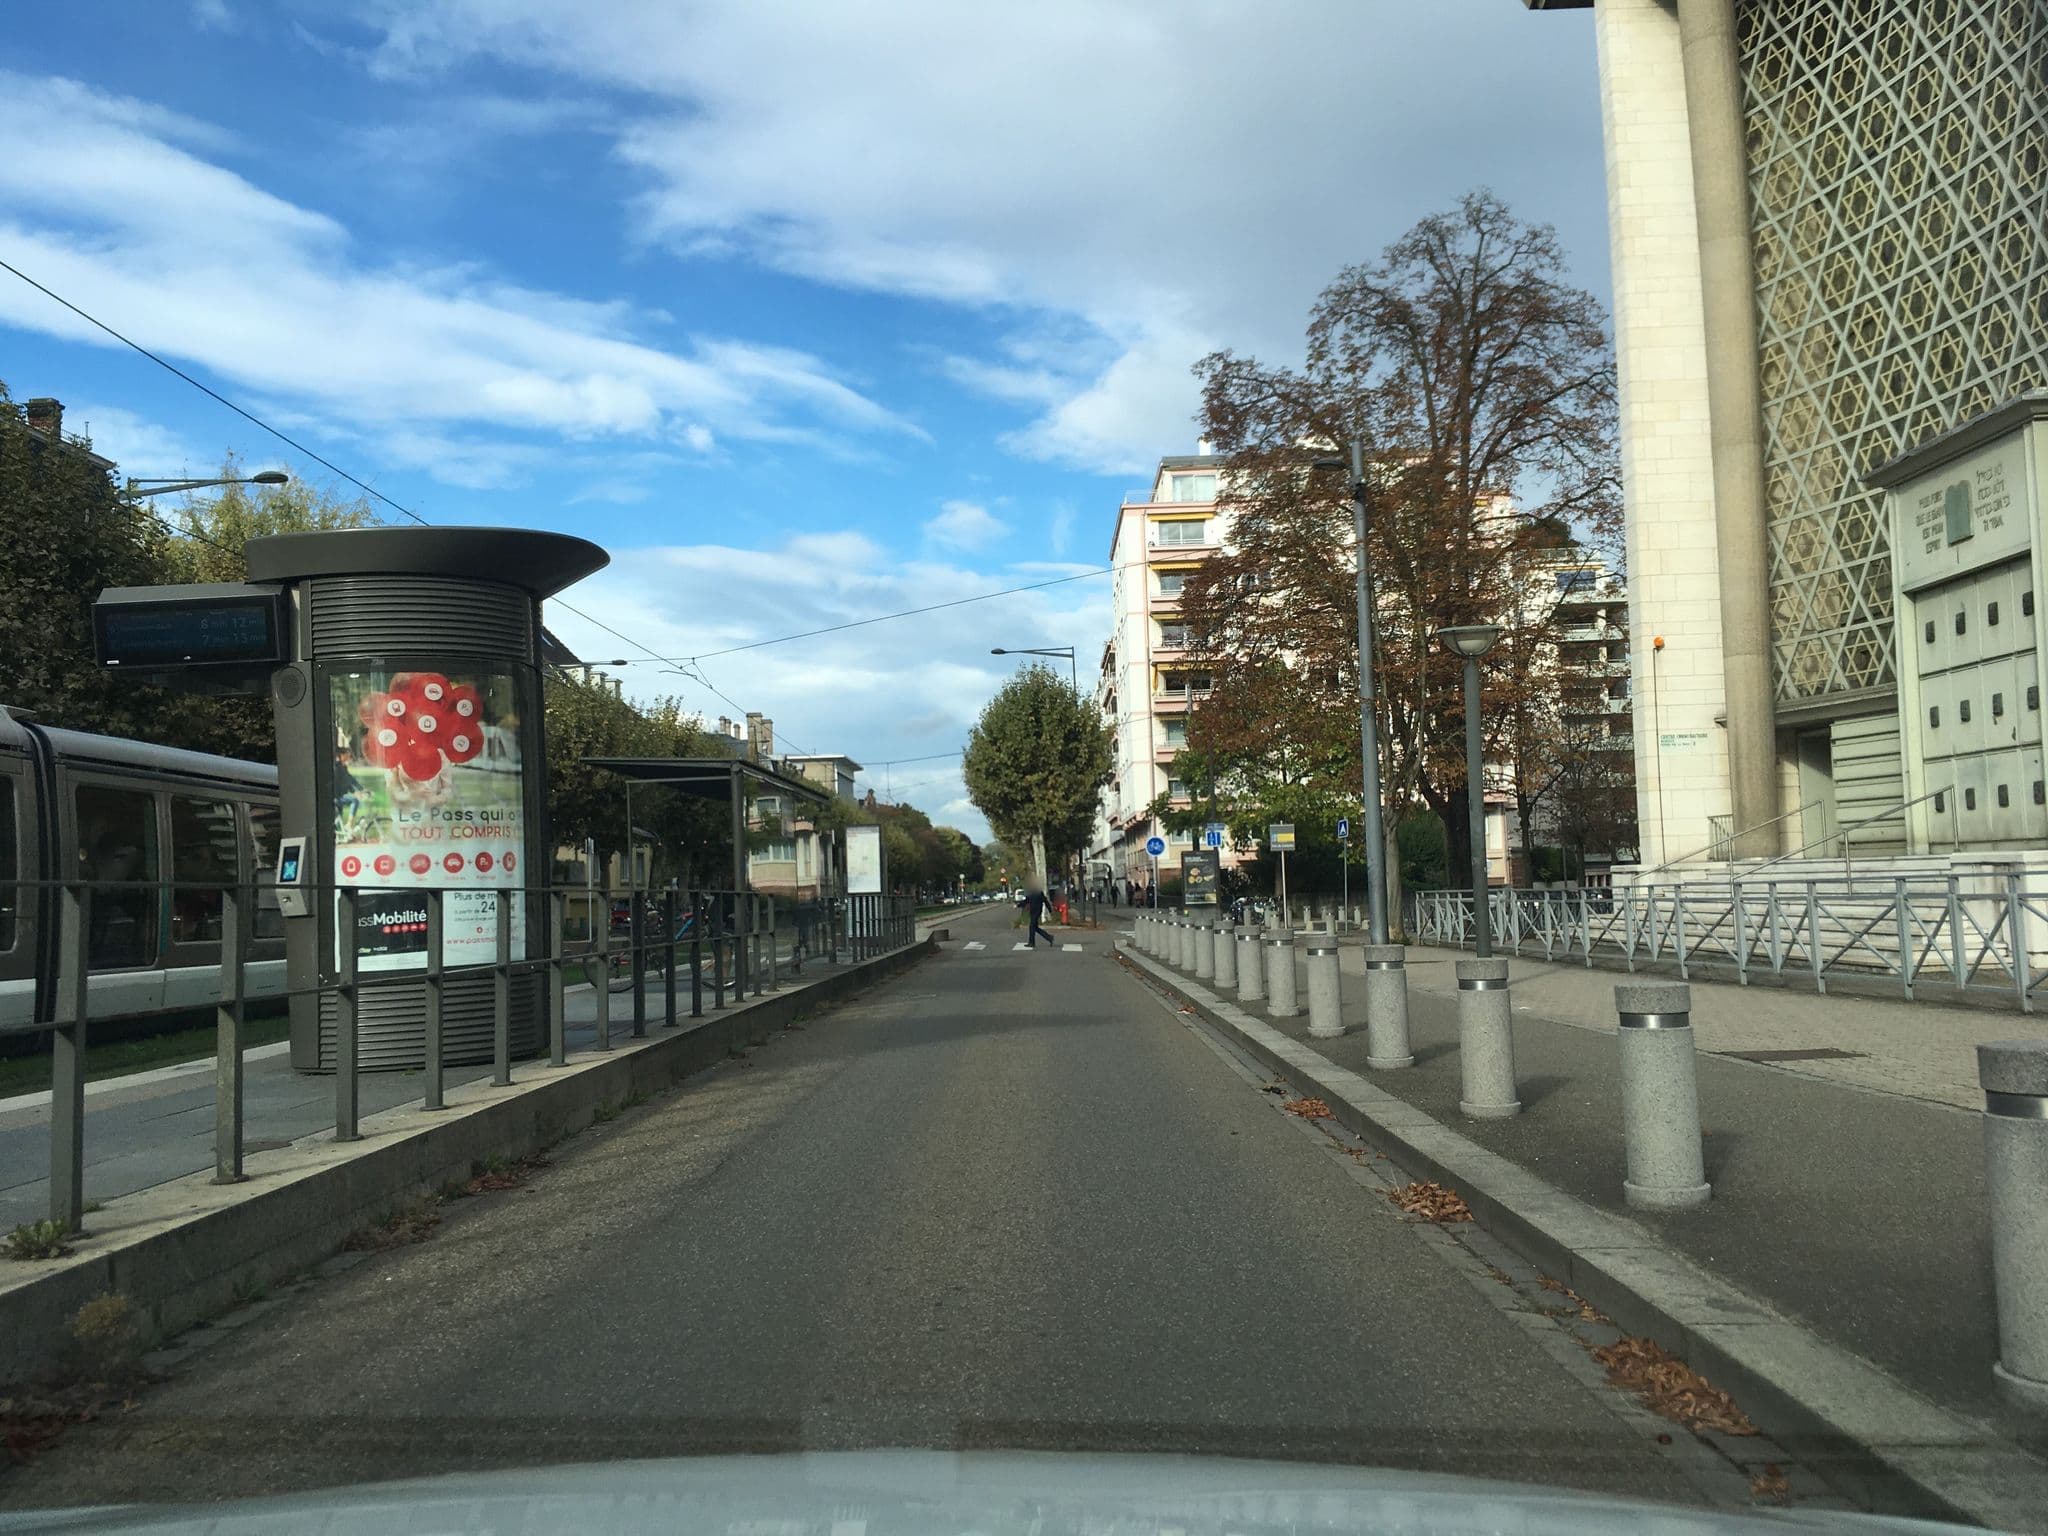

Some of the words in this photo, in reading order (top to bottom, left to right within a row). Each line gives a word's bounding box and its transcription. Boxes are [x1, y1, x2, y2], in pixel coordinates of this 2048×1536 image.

[399, 807, 422, 822] Le
[430, 806, 474, 821] Pass
[480, 808, 504, 825] qui
[400, 826, 445, 840] TOUT
[450, 825, 511, 839] COMPRIS
[454, 891, 472, 901] Plus
